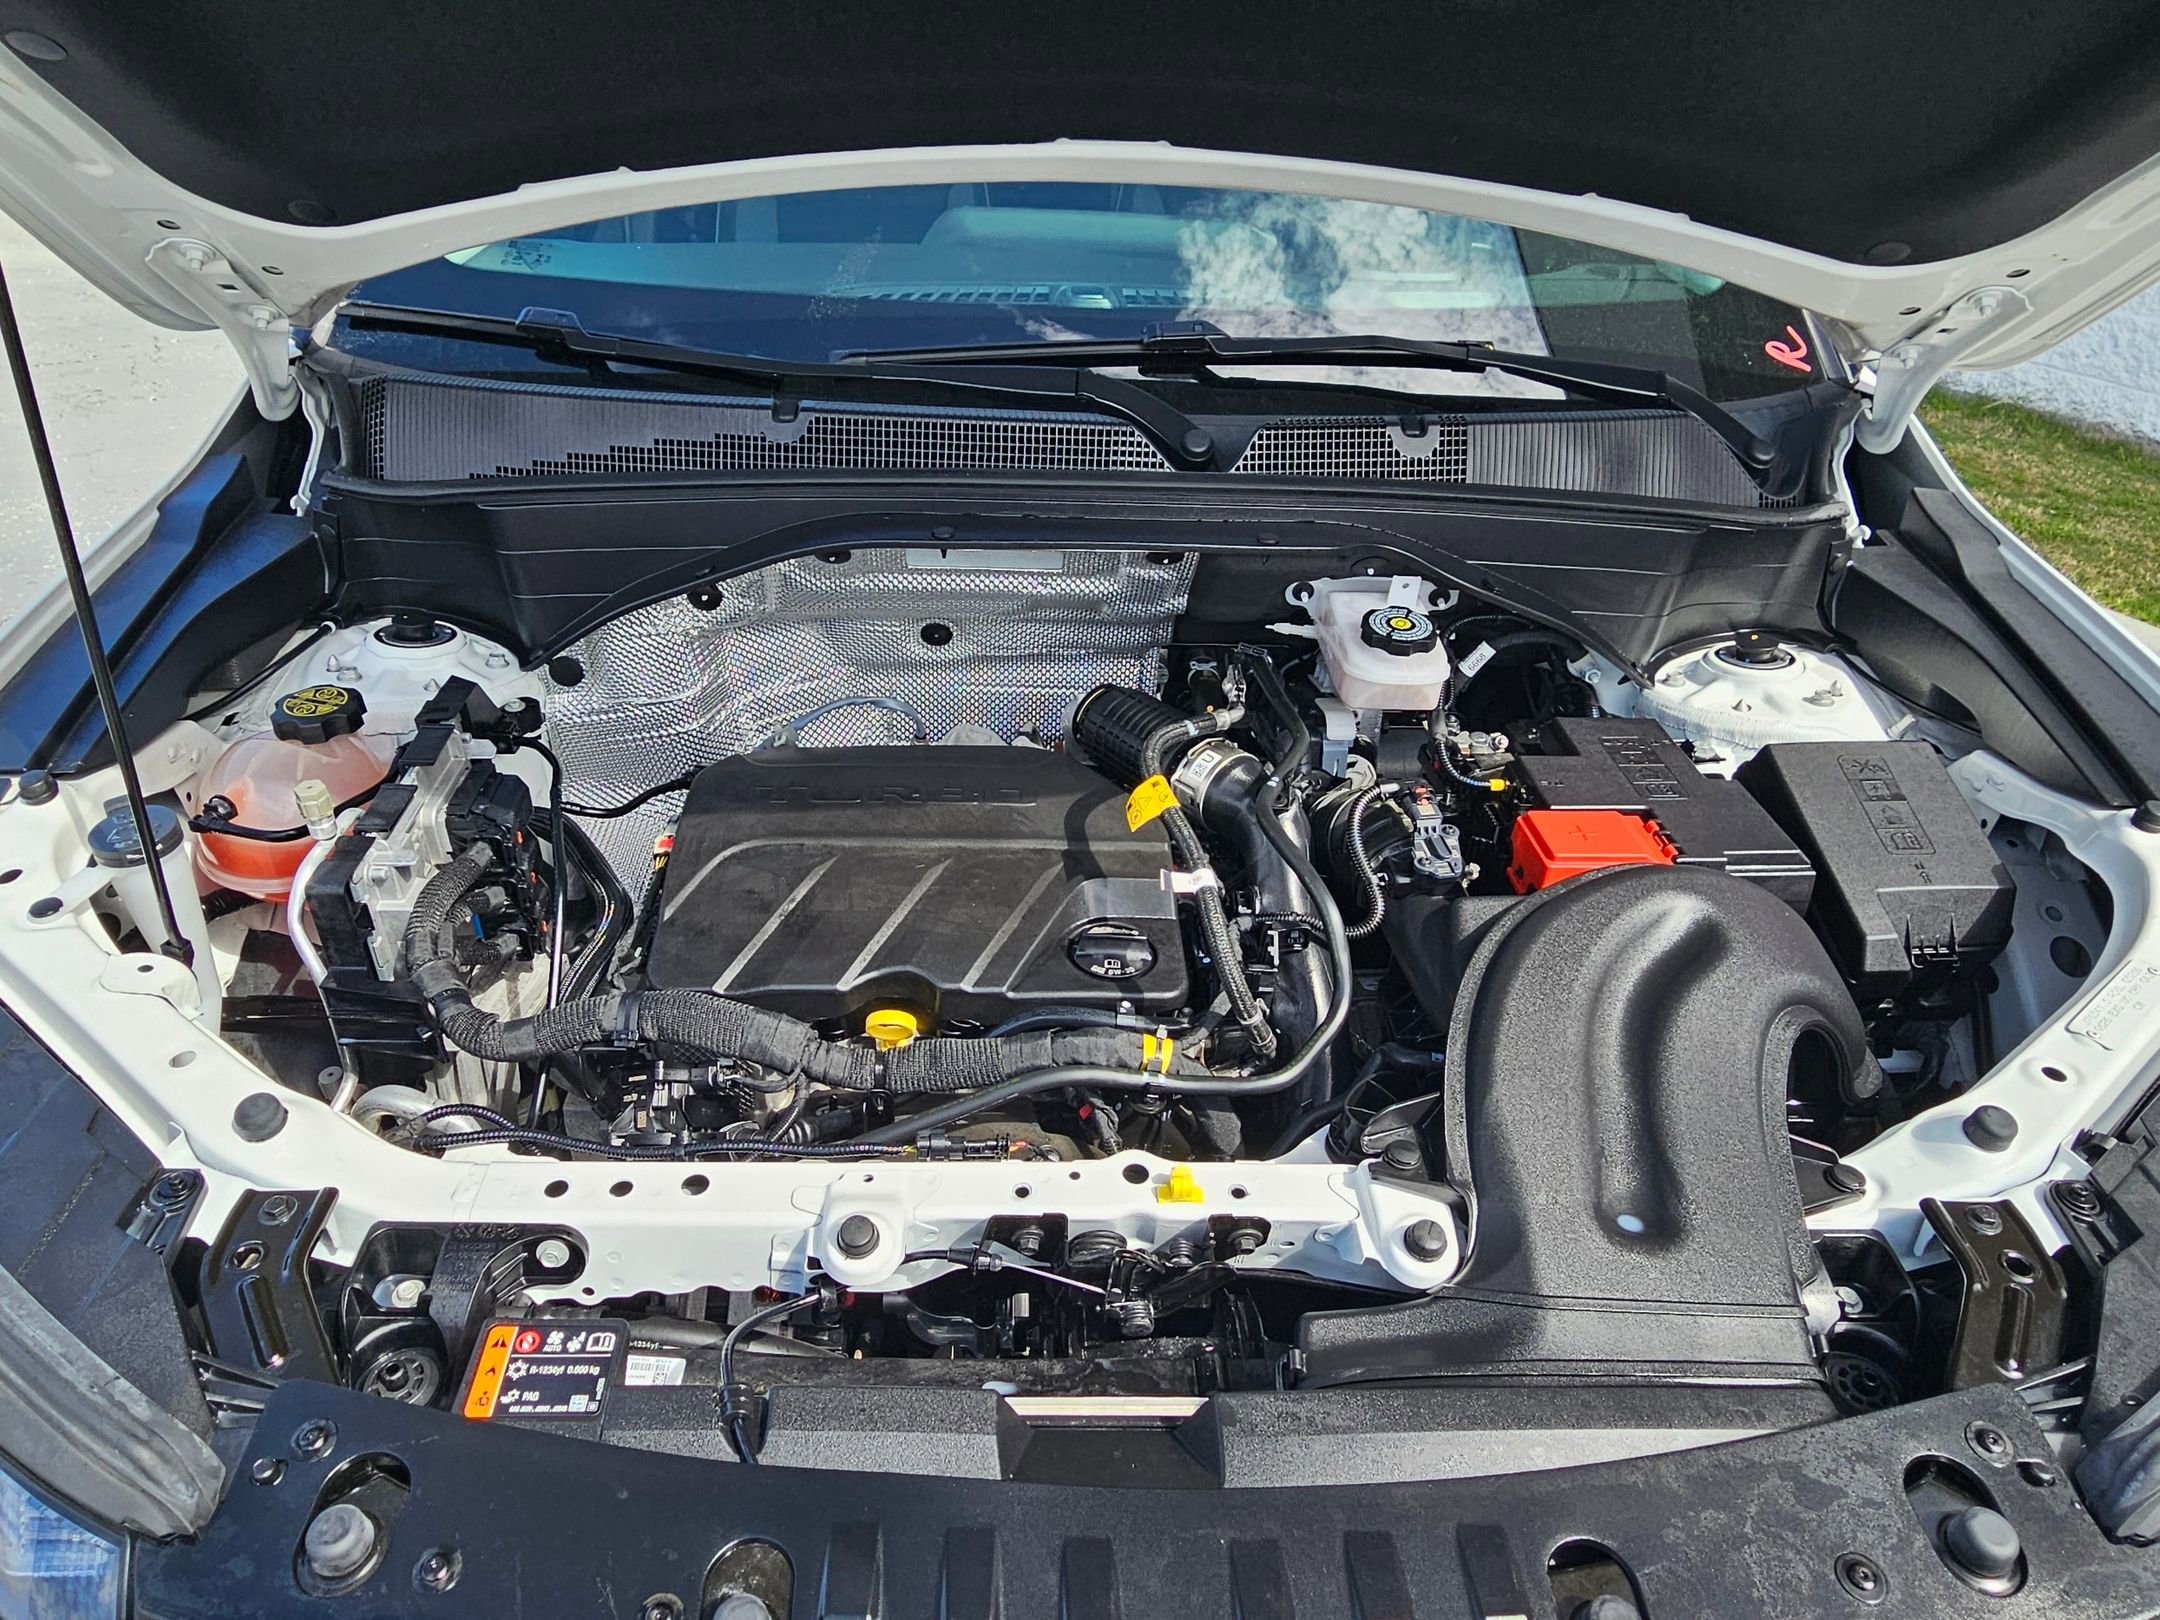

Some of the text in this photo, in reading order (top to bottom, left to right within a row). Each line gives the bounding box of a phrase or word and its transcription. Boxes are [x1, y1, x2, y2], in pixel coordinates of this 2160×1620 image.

[543, 1344, 562, 1352] AUTO
[529, 1364, 565, 1376] R-1234yf
[589, 1364, 600, 1375] kg
